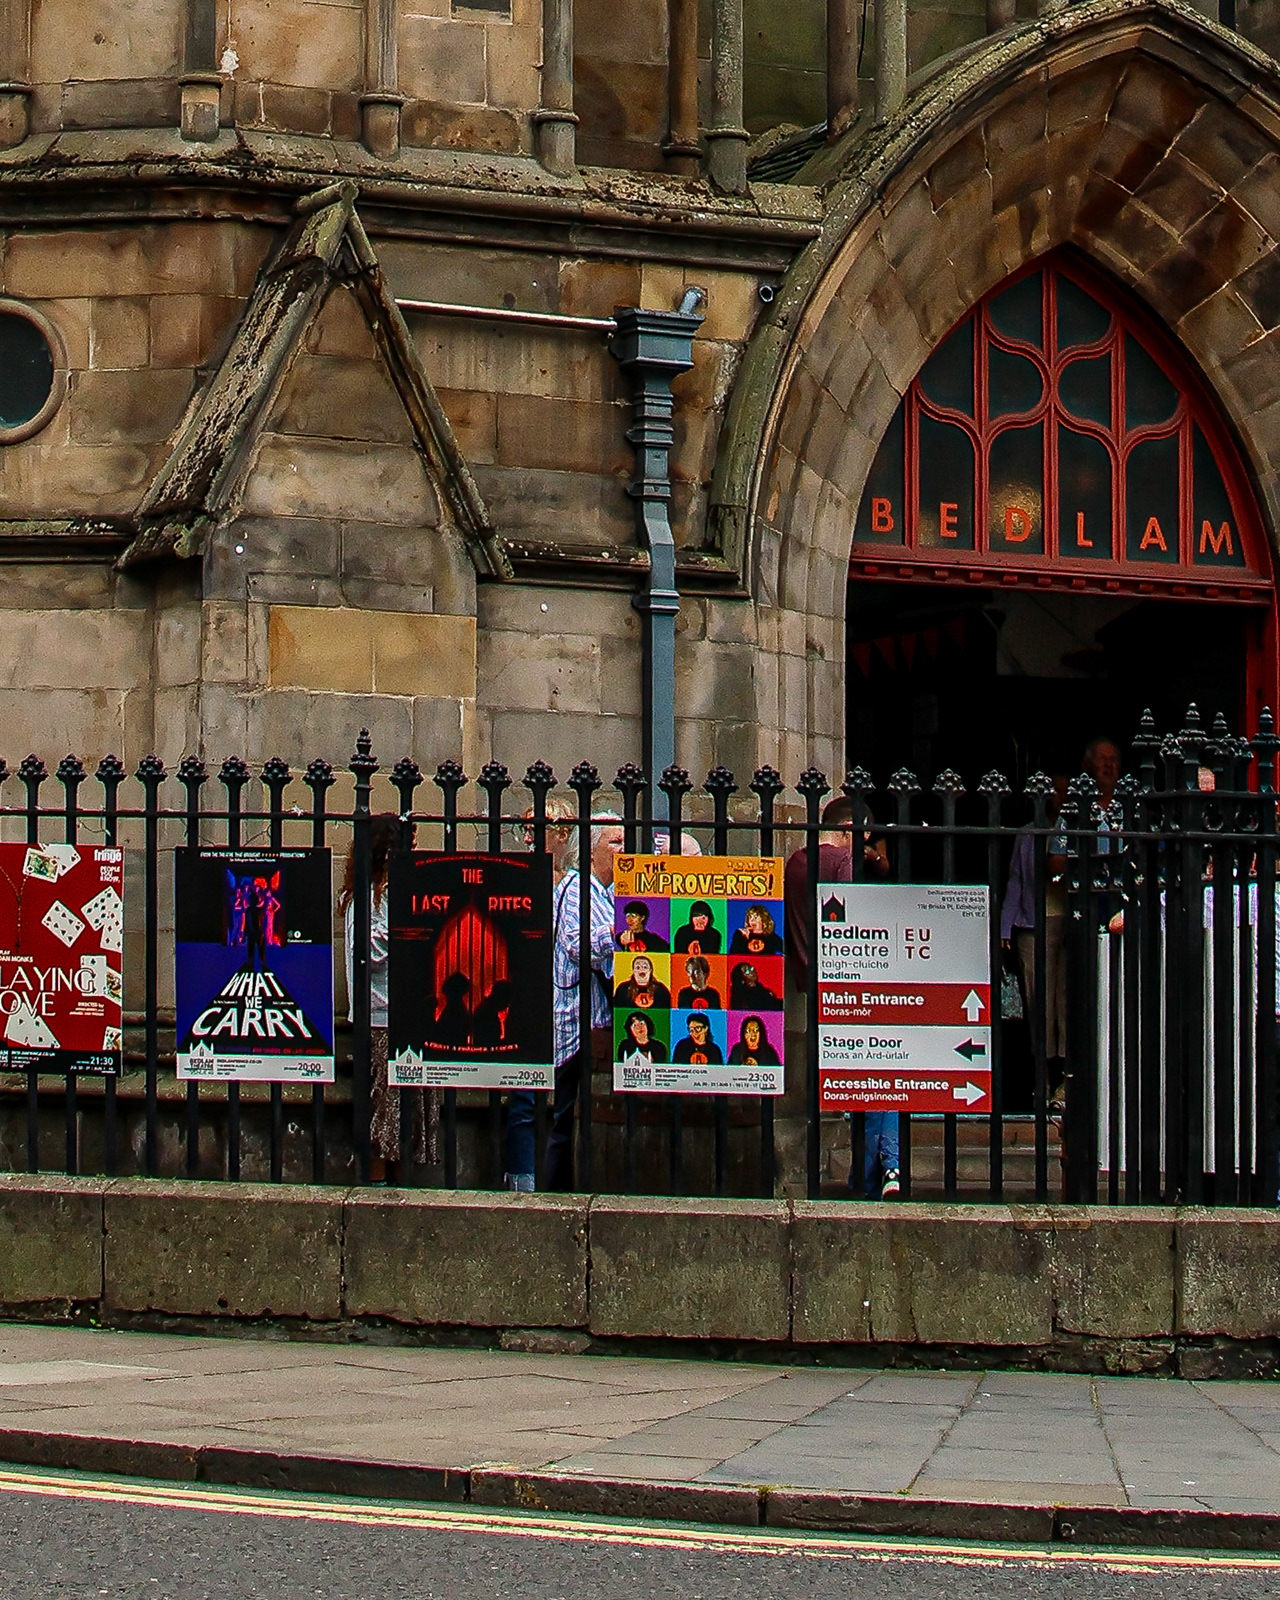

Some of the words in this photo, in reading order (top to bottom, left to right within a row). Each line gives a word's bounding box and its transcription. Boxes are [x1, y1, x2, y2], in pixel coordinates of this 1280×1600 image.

[872, 497, 1234, 556] BEDLAM
[94, 849, 122, 863] fringe
[644, 861, 667, 873] THE
[462, 868, 483, 884] THE
[635, 872, 774, 896] IMPROVERTS!
[412, 895, 450, 915] LAST
[488, 896, 532, 913] RITES
[821, 926, 889, 940] bedlam
[821, 943, 889, 957] theatre
[821, 960, 889, 970] taigh-cluiche
[822, 971, 861, 980] bedlam
[220, 972, 285, 997] WHAT
[245, 997, 263, 1009] WE
[822, 992, 857, 1005] Main
[861, 993, 924, 1006] Entrance
[823, 1007, 871, 1017] Doras-mòr
[191, 1007, 313, 1039] CARRY
[822, 1036, 864, 1050] Stage
[868, 1037, 903, 1049] Door
[90, 1056, 114, 1065] 21:30
[823, 1051, 850, 1060] Doras
[298, 1063, 321, 1071] 20:00
[518, 1071, 545, 1080] 20:00
[748, 1073, 775, 1082] 23:00
[823, 1078, 891, 1090] Accessible
[894, 1079, 950, 1090] Entrance
